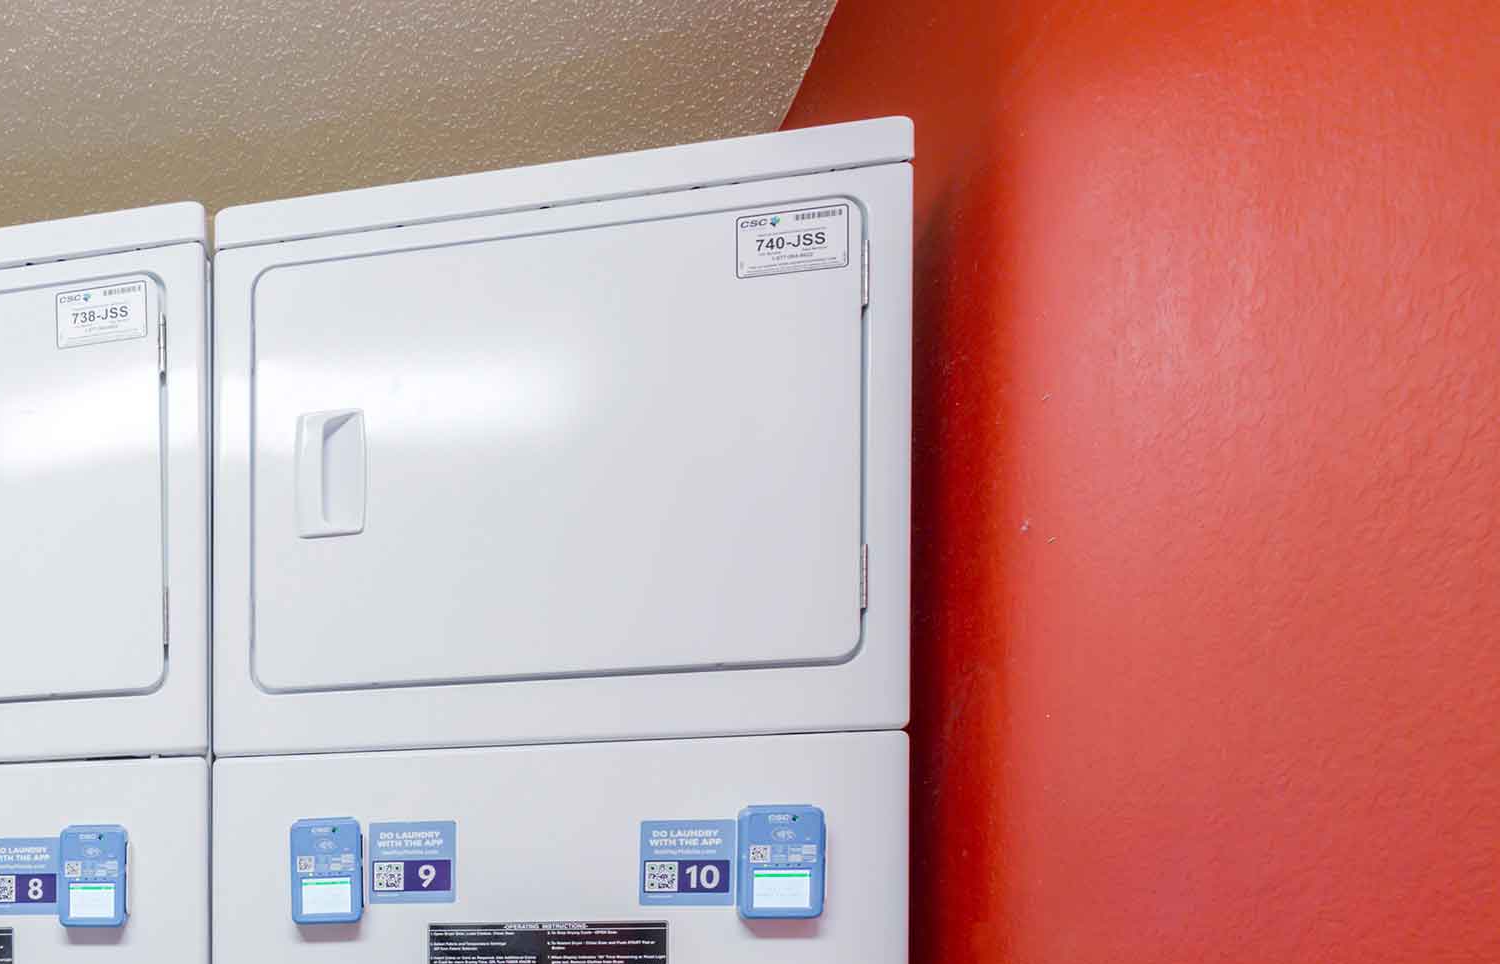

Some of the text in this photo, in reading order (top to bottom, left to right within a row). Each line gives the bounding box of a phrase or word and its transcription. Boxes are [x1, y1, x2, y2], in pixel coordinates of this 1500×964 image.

[740, 218, 768, 229] CSC
[756, 232, 826, 252] 740-JSS
[59, 295, 81, 304] CSC
[71, 305, 129, 324] 738-JSS
[379, 831, 441, 840] DO LAUNDRY
[652, 829, 720, 838] DO LAUNDRY
[377, 839, 444, 848] WITH THE APP
[649, 838, 723, 847] WITH THE APP
[418, 864, 437, 888] 9
[685, 864, 721, 889] 10
[27, 878, 43, 900] 8
